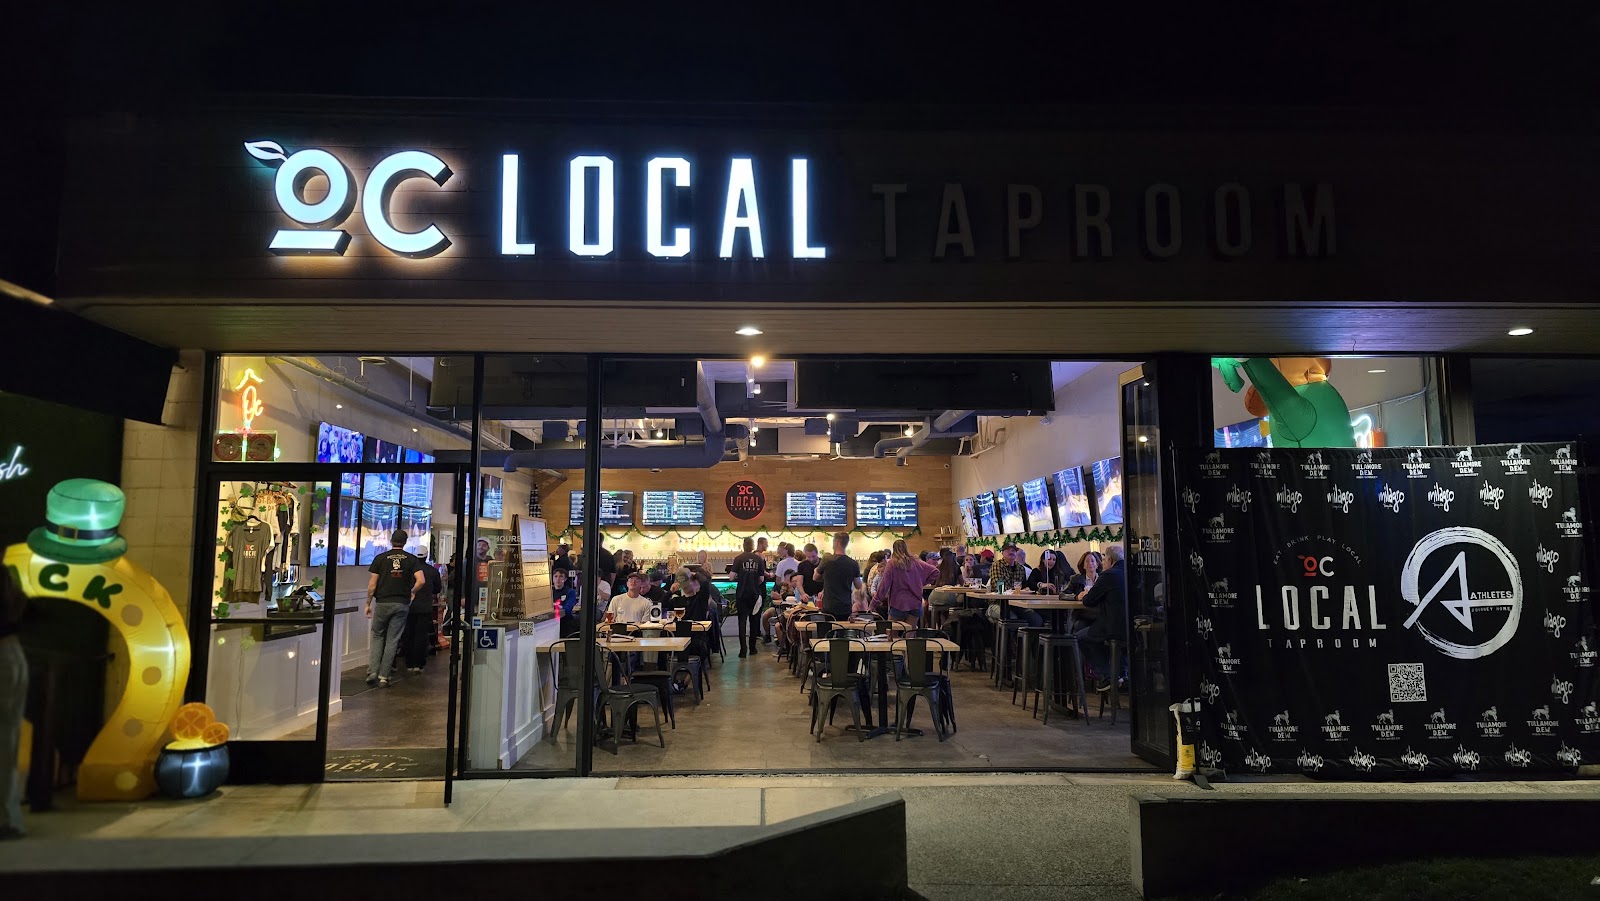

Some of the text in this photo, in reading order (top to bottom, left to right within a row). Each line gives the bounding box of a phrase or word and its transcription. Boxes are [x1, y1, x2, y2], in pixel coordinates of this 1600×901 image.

[257, 144, 1338, 260] OC LOCAL TAPROOM
[730, 496, 760, 506] LOCAL
[1276, 483, 1302, 513] milagro
[1326, 483, 1354, 513] milagro
[1378, 482, 1405, 513] milagro
[1427, 482, 1454, 512] milagro
[1479, 480, 1505, 510] milagro
[1298, 555, 1334, 577] OC
[1256, 584, 1387, 630] LOCAL
[1470, 590, 1513, 600] ATHLETES
[1266, 638, 1377, 648] TAPROOM
